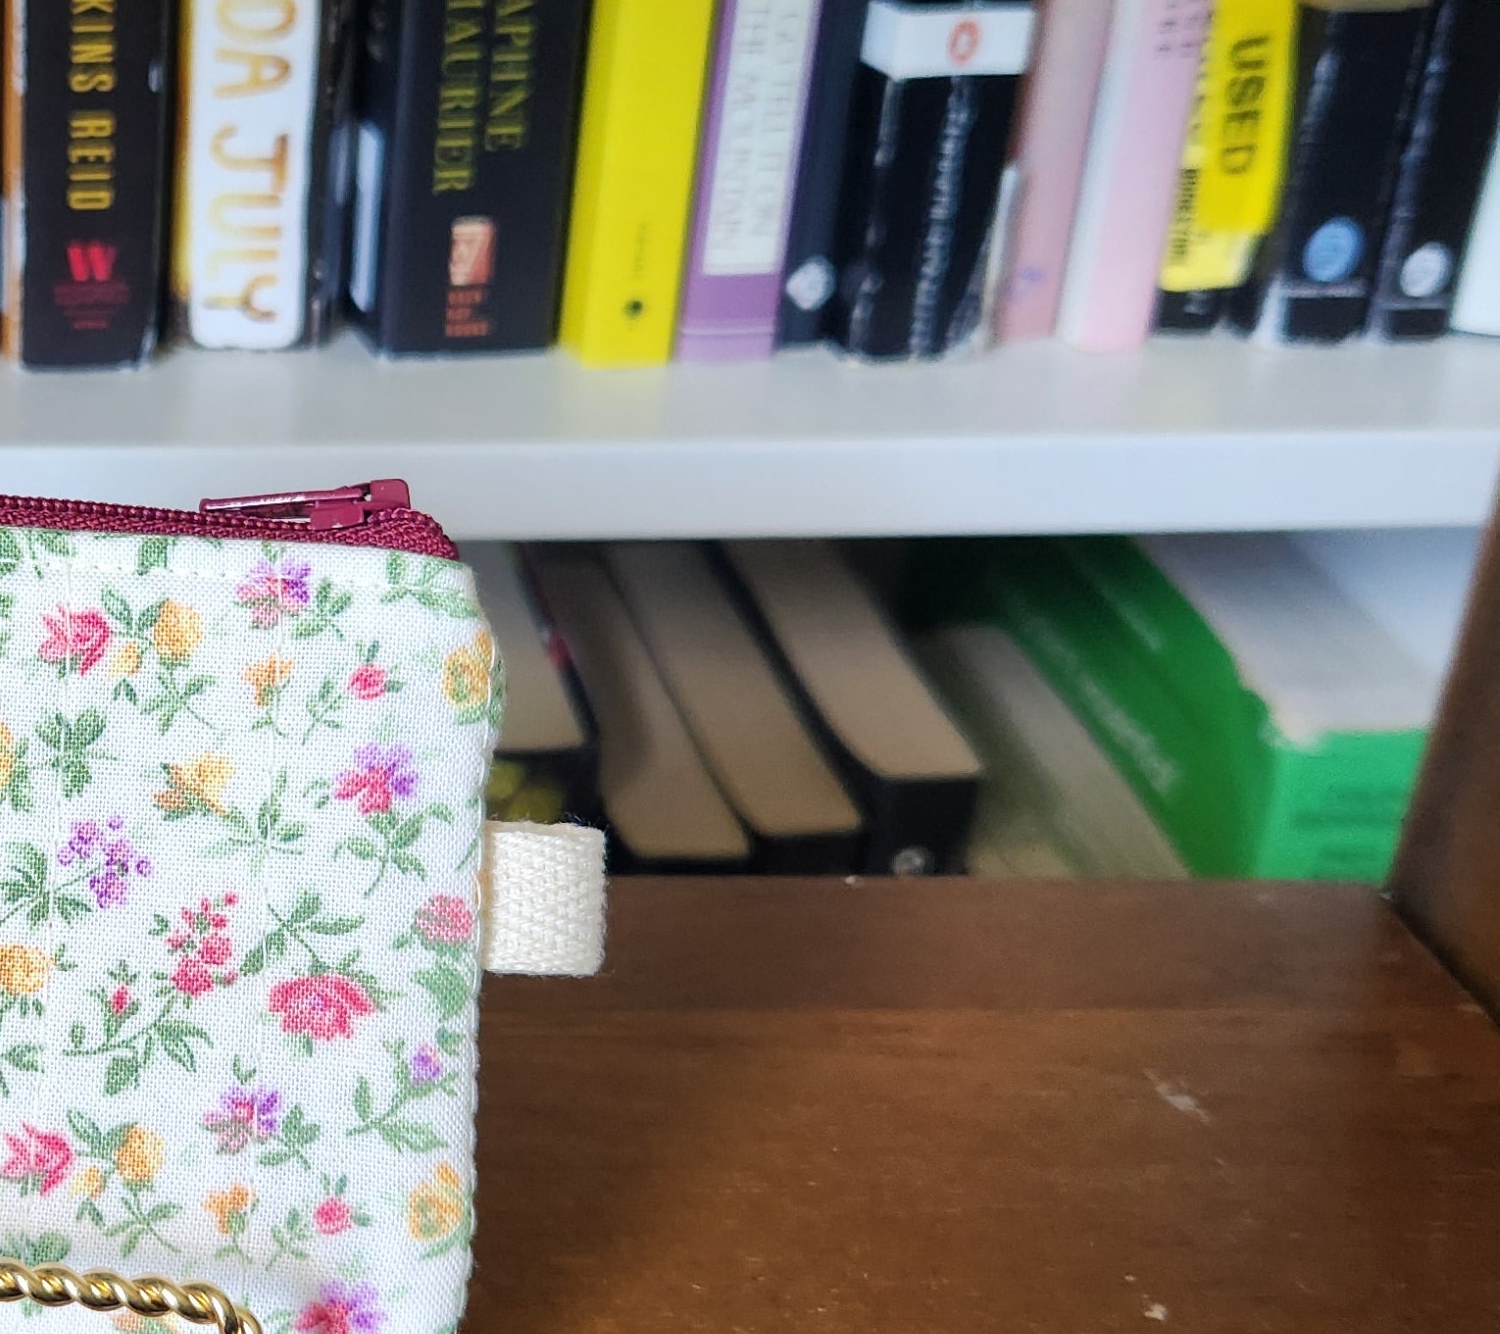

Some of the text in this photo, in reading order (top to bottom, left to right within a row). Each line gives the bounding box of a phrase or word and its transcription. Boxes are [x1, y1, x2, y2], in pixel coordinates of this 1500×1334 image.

[66, 108, 117, 212] REID
[1218, 33, 1271, 177] USED
[202, 124, 290, 325] JULY
